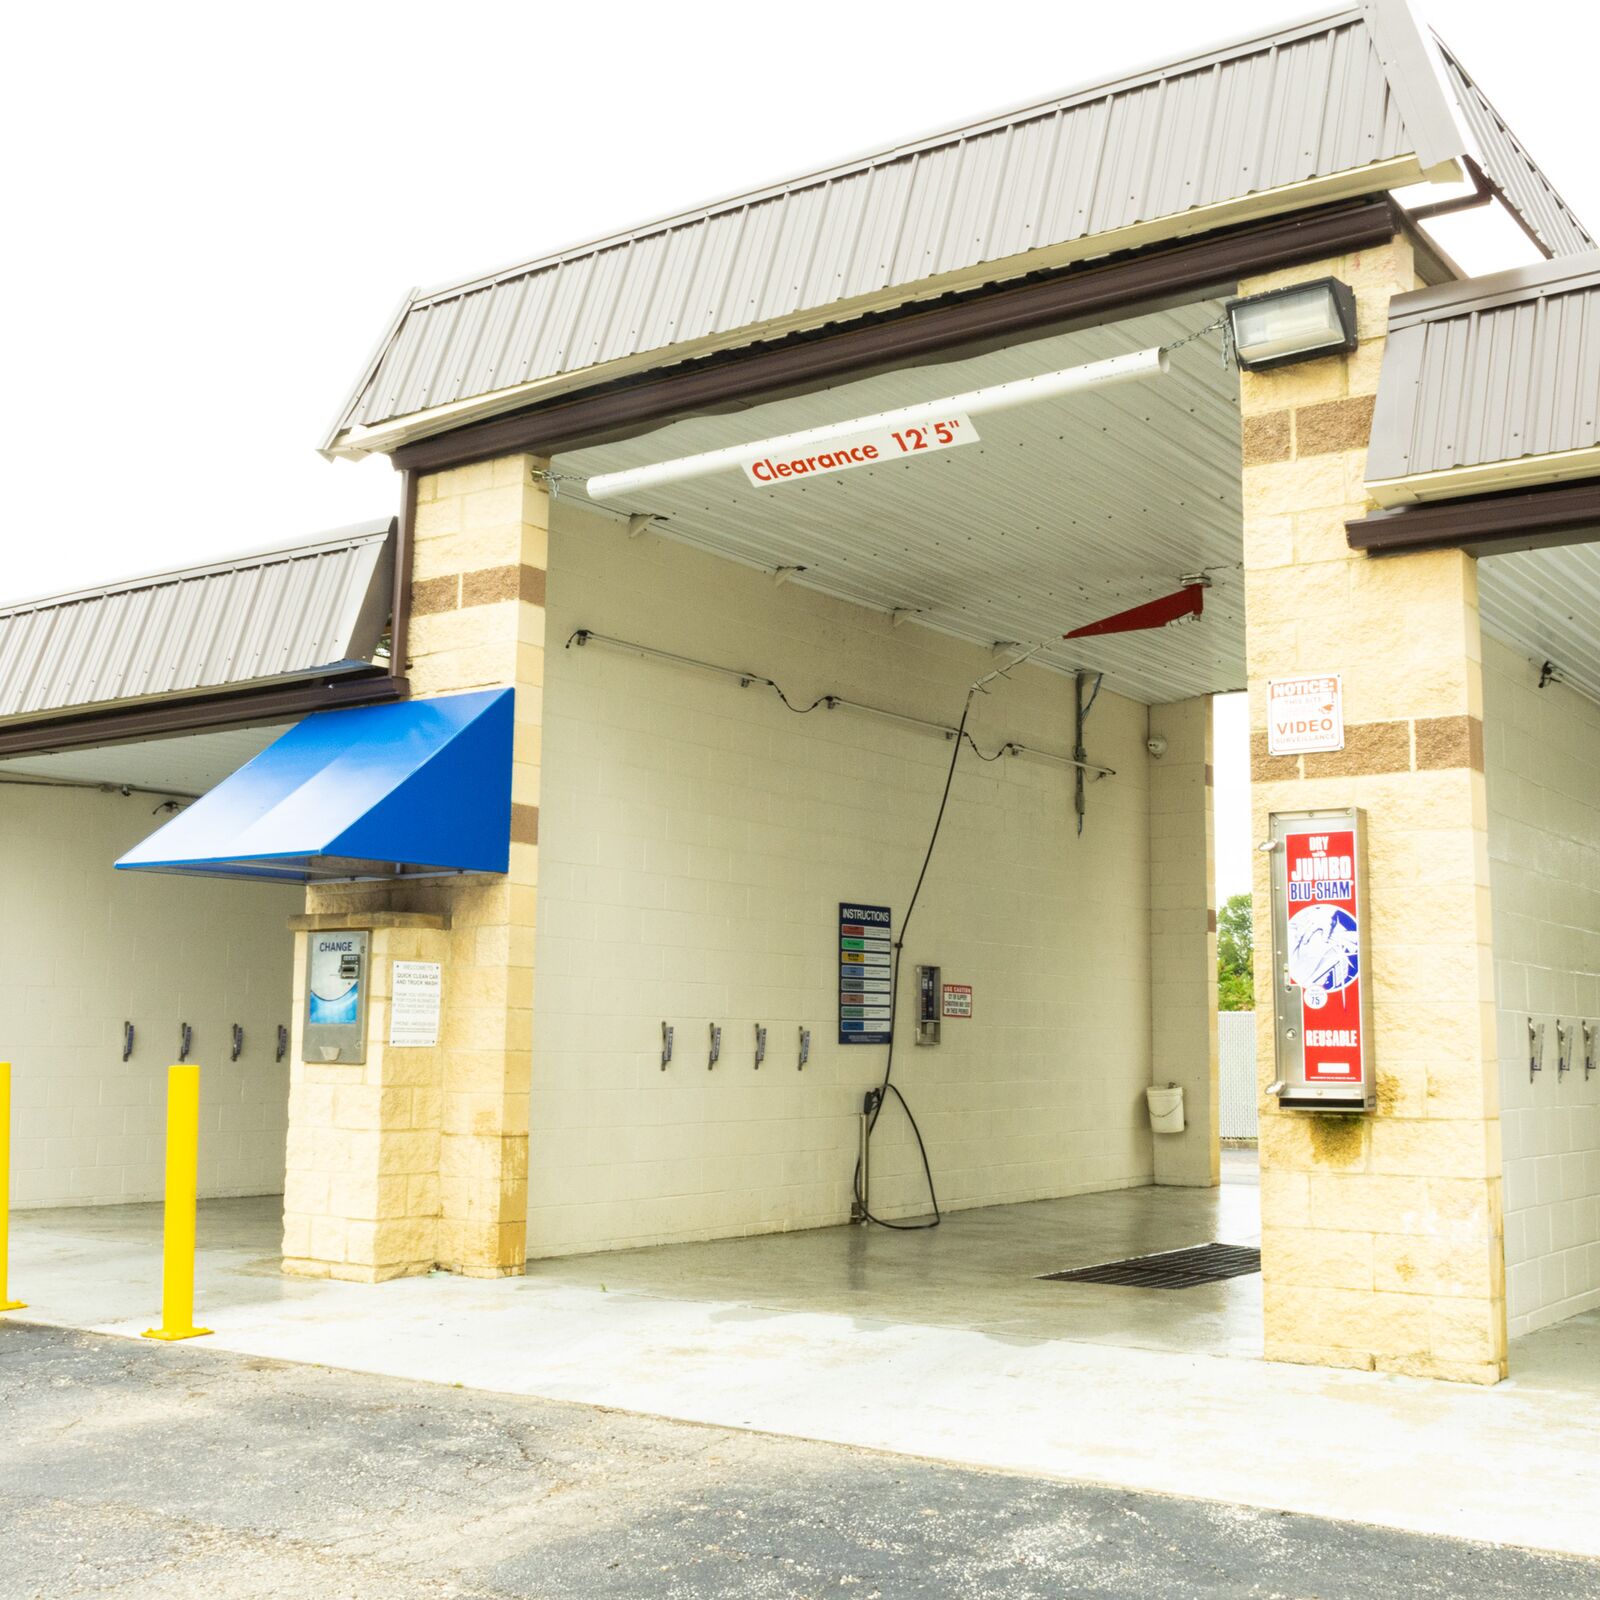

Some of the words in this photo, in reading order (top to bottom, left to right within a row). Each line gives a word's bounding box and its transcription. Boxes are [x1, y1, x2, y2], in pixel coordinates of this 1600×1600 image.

[752, 445, 879, 481] Clearance
[1277, 718, 1333, 735] VIDEO
[1276, 733, 1335, 744] SURVEILLANCE
[1309, 836, 1329, 851] DRY
[1291, 856, 1351, 881] JUMBO
[1291, 881, 1349, 900] BLU-SHAM
[843, 909, 889, 922] INSTRUCTIONS
[320, 942, 352, 952] CHANGE
[1306, 1030, 1357, 1047] REUSABLE
